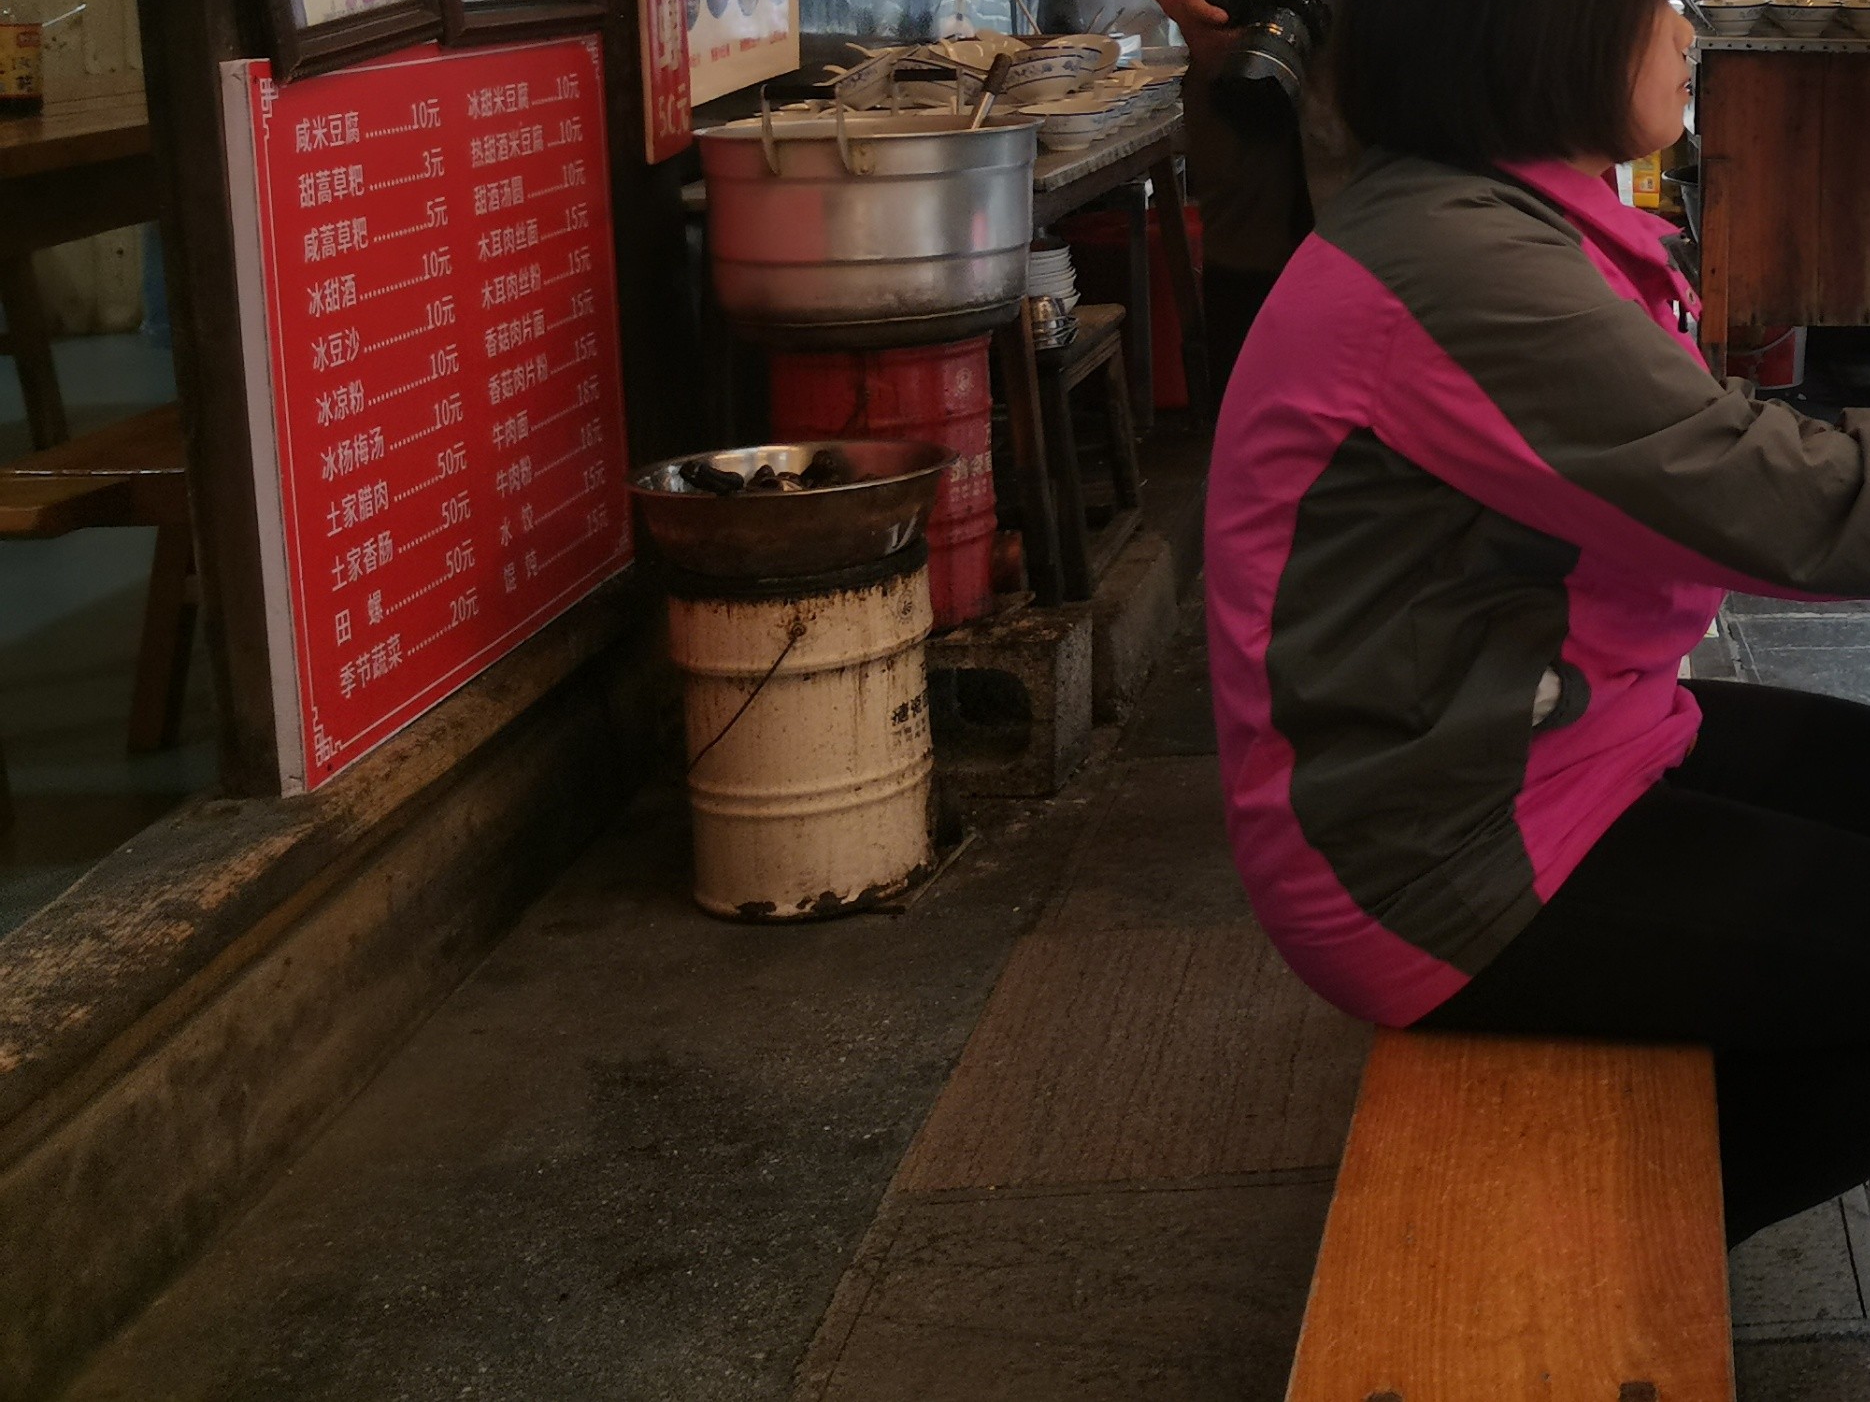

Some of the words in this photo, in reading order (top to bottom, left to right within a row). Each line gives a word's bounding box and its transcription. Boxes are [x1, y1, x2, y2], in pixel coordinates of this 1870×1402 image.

[556, 73, 580, 100] 10元
[295, 110, 361, 154] 咸米豆腐
[412, 98, 442, 130] 10元
[422, 146, 445, 179] 3元
[559, 116, 583, 145] 10元
[562, 159, 587, 188] 10元
[426, 196, 449, 228] 5元
[565, 202, 589, 232] 15元
[307, 273, 358, 318] 冰甜酒
[422, 245, 453, 280] 10元
[311, 326, 361, 373] 冰豆沙
[425, 295, 456, 330] 10元
[315, 379, 365, 427] 冰凉粉
[430, 343, 461, 380] 10元
[321, 426, 385, 483] 冰杨梅汤
[434, 392, 464, 431] 10元
[326, 478, 390, 538] 土家腊肉
[437, 441, 468, 480] 50元
[331, 530, 394, 593] 土家香肠
[441, 490, 472, 530] 50元
[334, 589, 384, 647] 田螺
[445, 538, 476, 580] 50元
[340, 632, 403, 699] 季节蔬菜
[450, 587, 480, 628] 20元
